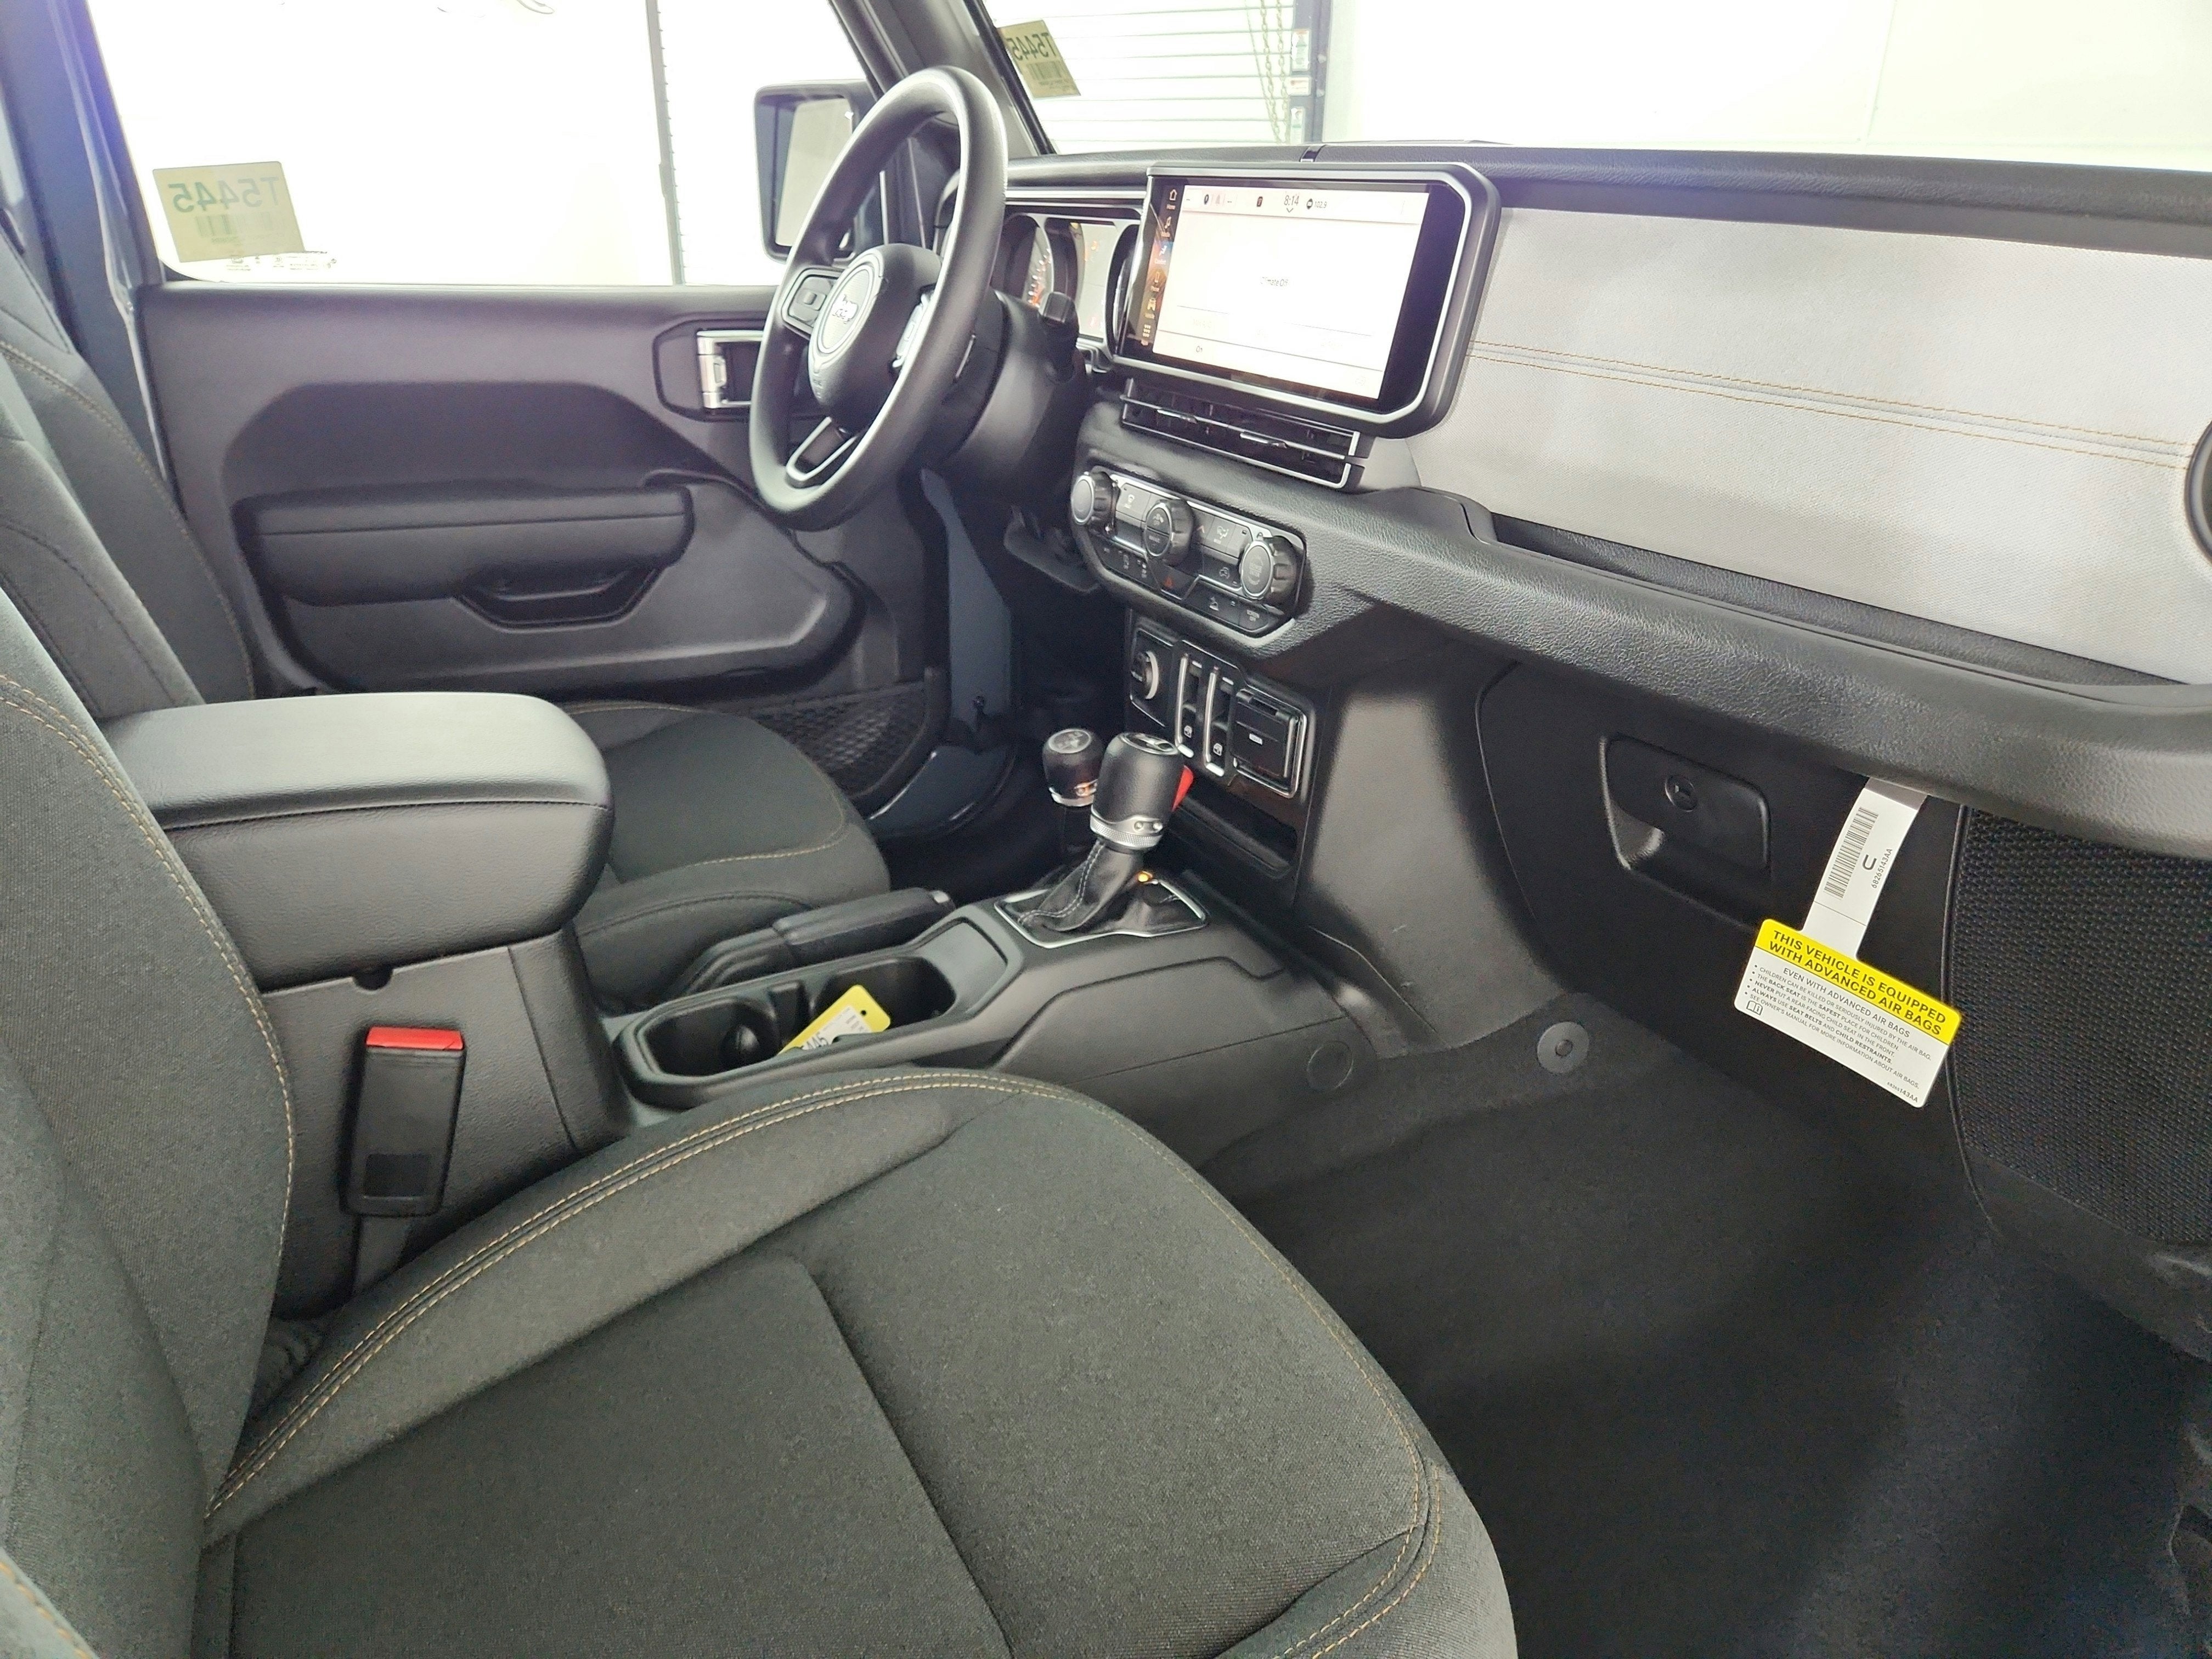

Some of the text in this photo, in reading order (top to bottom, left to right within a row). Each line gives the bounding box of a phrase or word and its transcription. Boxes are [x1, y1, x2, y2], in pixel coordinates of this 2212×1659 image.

[1284, 195, 1300, 206] 8:14
[1862, 854, 1877, 871] U
[1871, 849, 1893, 889] 68265143AA
[1757, 973, 1768, 983] THE
[1768, 979, 1786, 991] BACK
[1785, 988, 1801, 997] SEAT
[1807, 997, 1818, 1007] THE
[1818, 1004, 1841, 1018] SAFEST
[1841, 1015, 1859, 1029] PLACE
[1858, 1025, 1871, 1035] FOR
[1759, 967, 1787, 983] CHILDREN
[1787, 980, 1799, 989] CAN
[1799, 985, 1807, 994] BE
[1807, 990, 1826, 1003] KILLED
[1835, 1004, 1865, 1023] SERIOUSLY
[1864, 1020, 1888, 1036] INJURED
[1897, 1037, 1908, 1047] THE
[1908, 1044, 1918, 1053] AIR
[1770, 940, 1942, 1035] WITH ADVANCED AIR BAGS
[1774, 930, 1946, 1023] THIS VEHICLE IS EQUIPPED
[1783, 967, 1910, 1038] EVEN WITH ADVANCED AIR BAGS
[1750, 994, 1760, 1002] SEE
[1785, 1011, 1808, 1027] MANUAL
[1808, 1023, 1820, 1032] FOR
[1820, 1029, 1837, 1042] MORE
[1836, 1038, 1874, 1062] INFORMATION
[1874, 1059, 1893, 1073] ABOUT
[1893, 1070, 1903, 1079] AIR
[1752, 988, 1892, 1065] ALWAYS USE SEAT BELTS AND CHILD RESTRAINTS.
[1754, 980, 1775, 994] NEVER
[1775, 990, 1787, 998] PUT
[1826, 1016, 1843, 1028] CHILD
[1843, 1025, 1857, 1036] SEAT
[1864, 1036, 1876, 1046] THE
